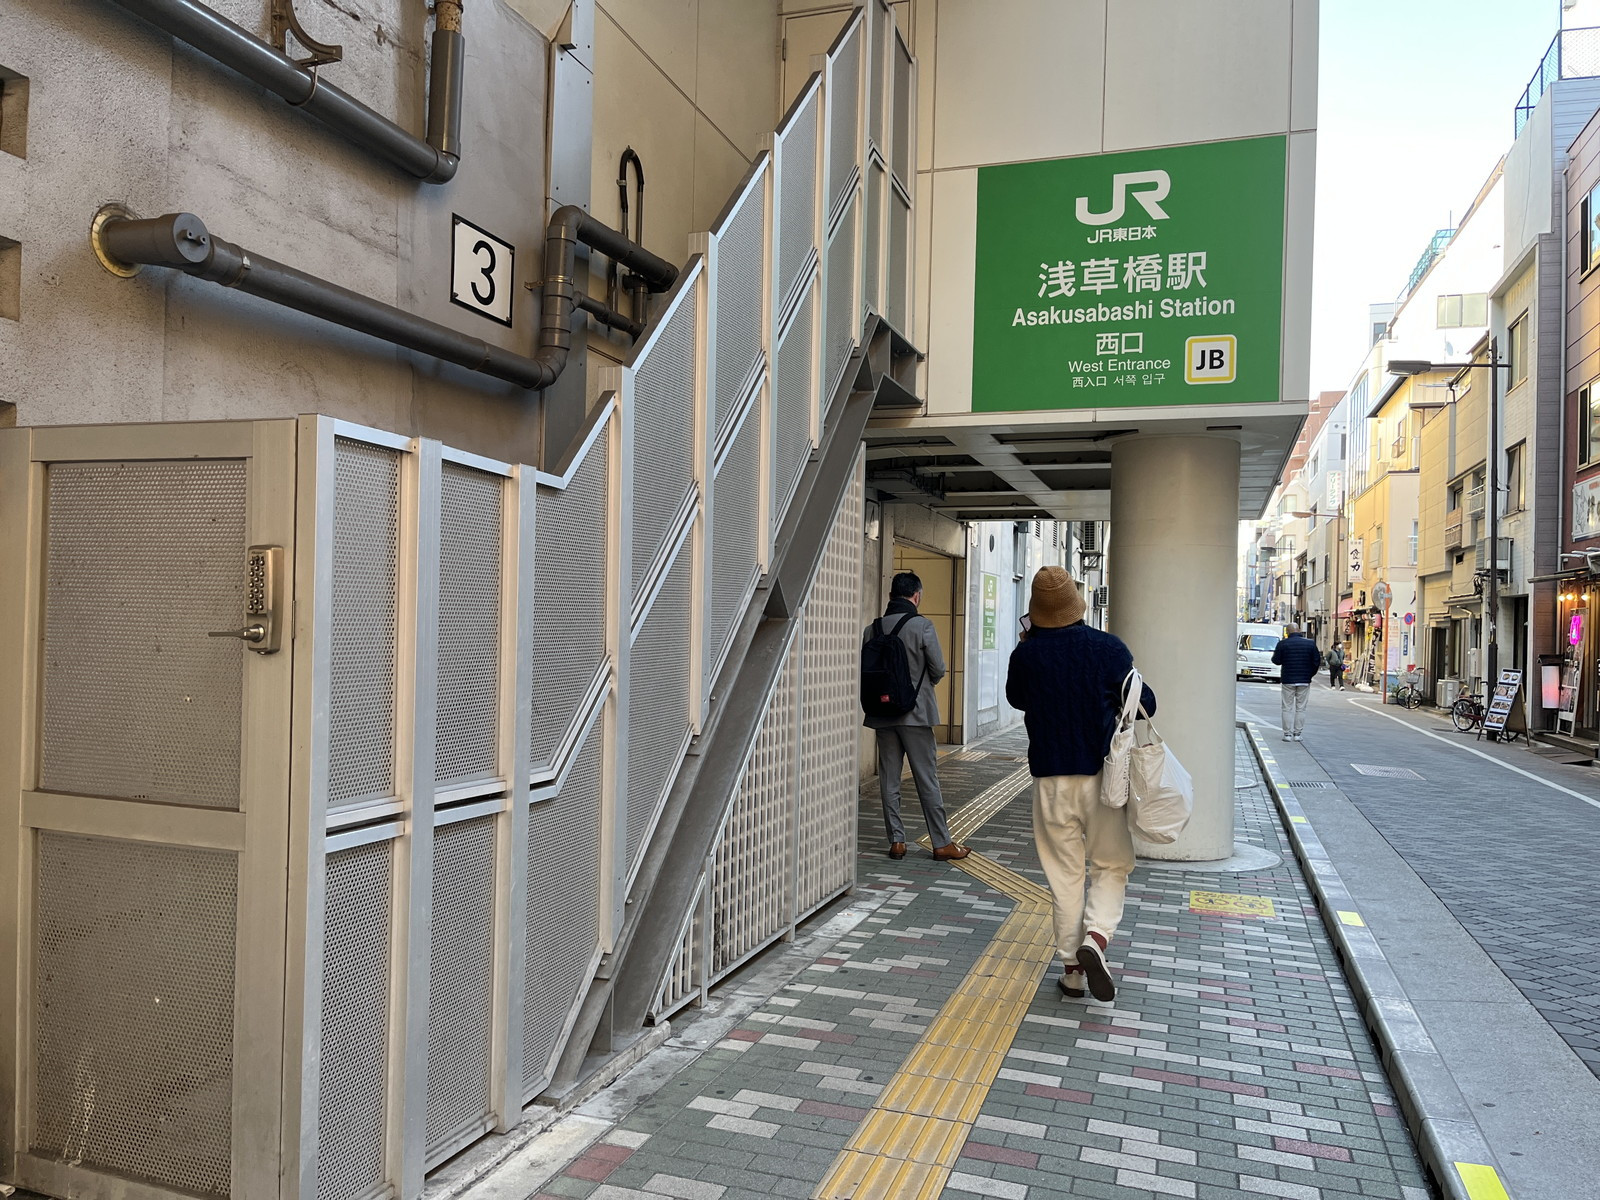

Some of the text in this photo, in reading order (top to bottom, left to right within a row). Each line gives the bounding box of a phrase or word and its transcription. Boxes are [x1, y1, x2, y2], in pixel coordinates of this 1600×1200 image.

[1075, 169, 1171, 226] JR
[1087, 225, 1157, 244] JR東日本
[470, 240, 496, 306] 3
[1037, 251, 1207, 299] 浅草橋駅
[1011, 296, 1235, 327] Asakusabashi Station
[1095, 332, 1144, 356] 西口
[1068, 358, 1171, 373] West Entrance
[1195, 349, 1225, 371] JB
[1072, 375, 1107, 388] 西入口
[1113, 373, 1166, 387] 서쪽 입구
